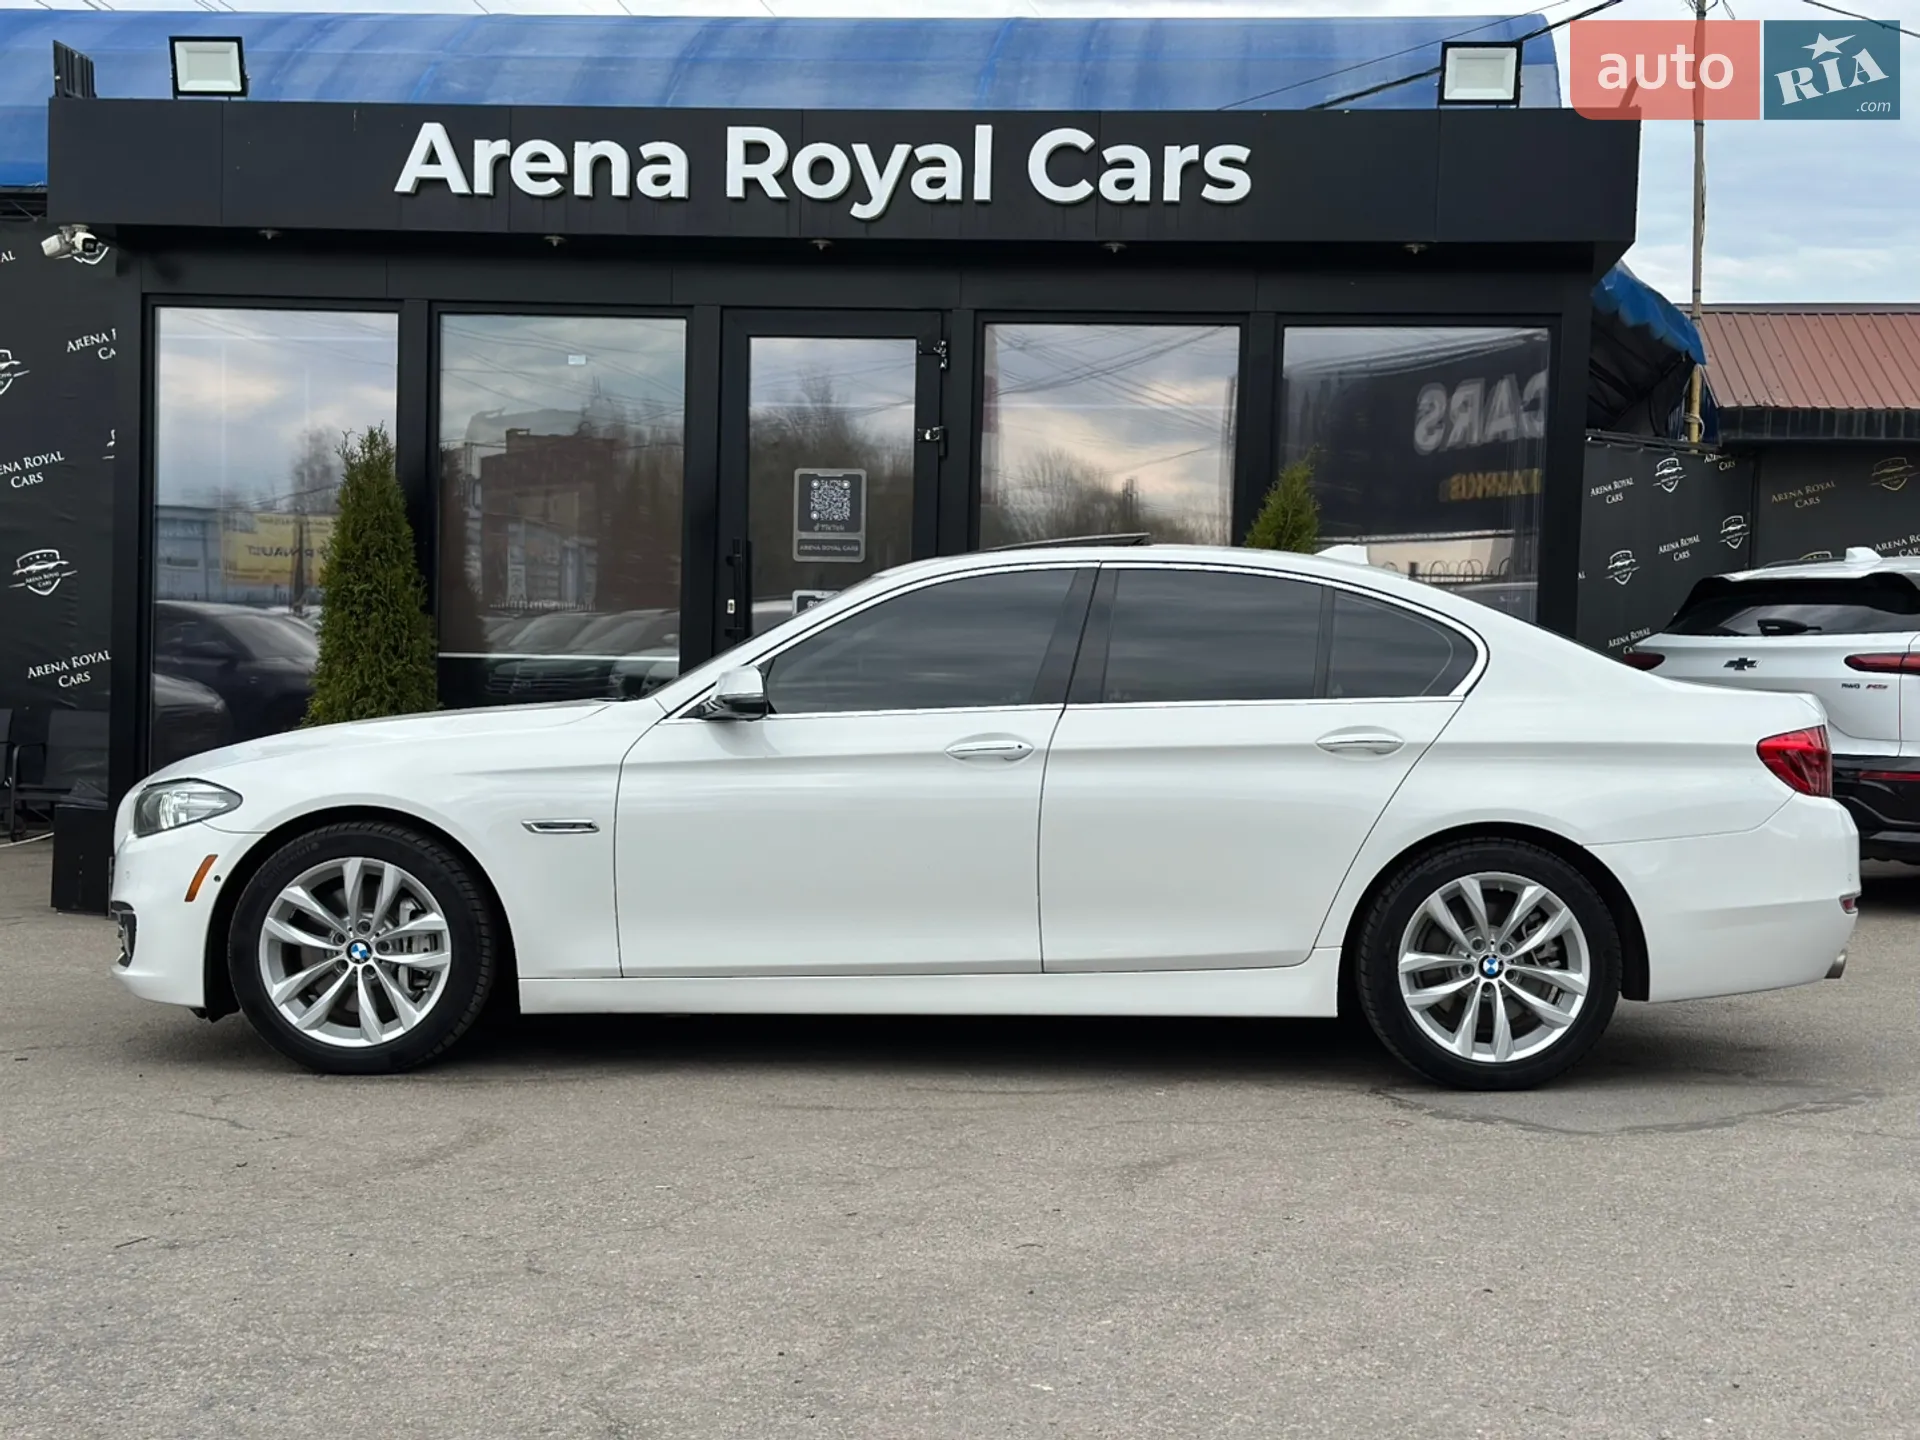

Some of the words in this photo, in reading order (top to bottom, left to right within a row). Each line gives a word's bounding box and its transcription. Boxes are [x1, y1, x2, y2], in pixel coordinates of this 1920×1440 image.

[394, 121, 690, 199] Arena
[726, 124, 994, 220] Royal
[1027, 126, 1252, 204] Cars
[66, 332, 109, 352] ARENA
[97, 346, 117, 360] CA
[0, 461, 22, 476] ENA
[23, 450, 65, 469] ROYAL
[10, 471, 44, 489] CARS
[1590, 484, 1613, 497] ARENA
[1613, 477, 1635, 491] ROYAL
[1606, 492, 1624, 504] CARS
[1771, 489, 1803, 503] ARENA
[1805, 480, 1836, 495] ROYAL
[1794, 496, 1821, 508] CARS
[1658, 541, 1680, 555] ARENA
[1680, 534, 1701, 547] ROYAL
[1875, 537, 1908, 553] ARENA
[1898, 543, 1920, 558] CAR
[1673, 549, 1691, 562] CARS
[27, 661, 70, 679] ARENA
[71, 650, 112, 668] ROYAL
[58, 671, 91, 688] CARS
